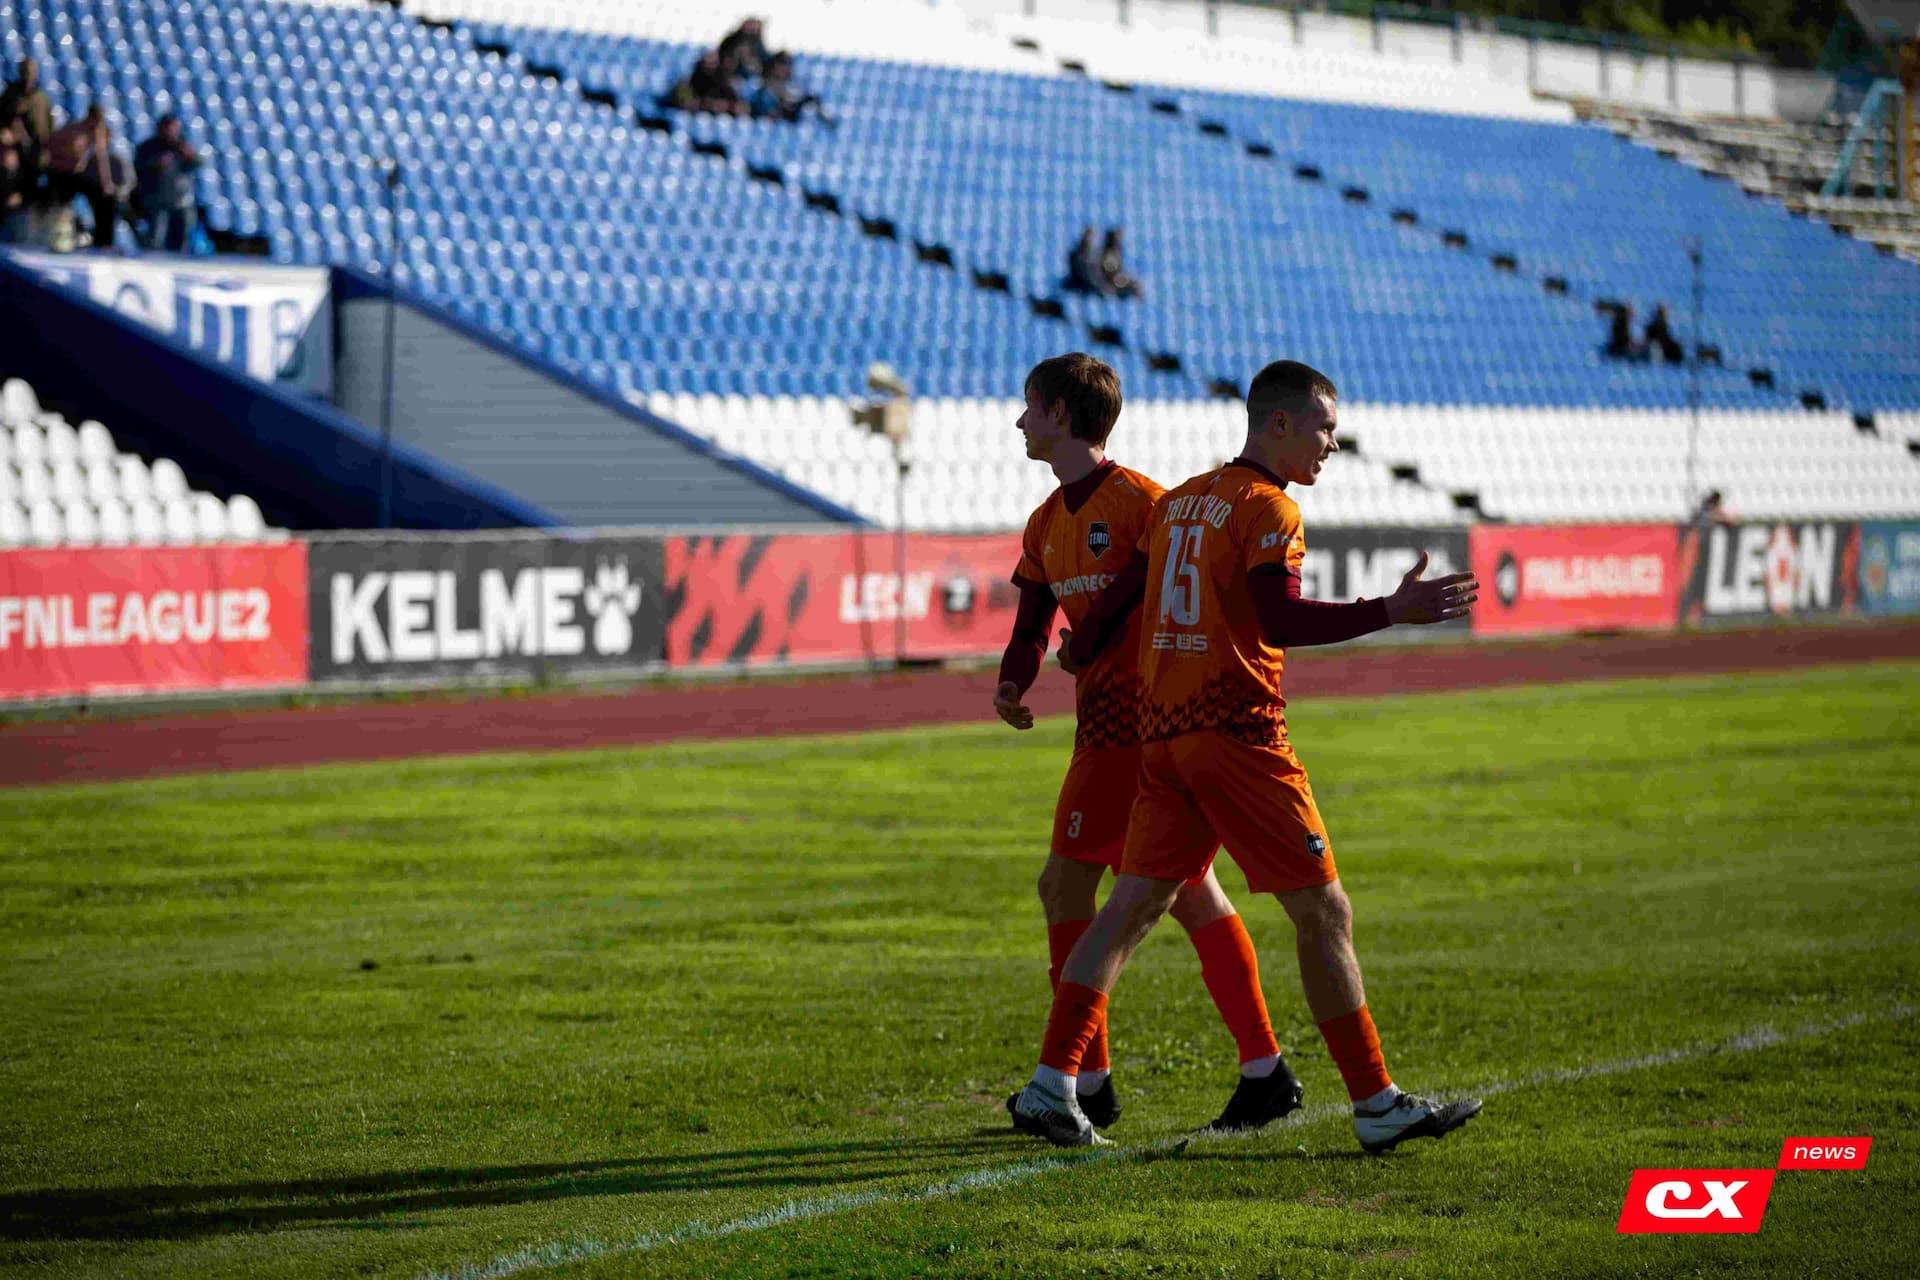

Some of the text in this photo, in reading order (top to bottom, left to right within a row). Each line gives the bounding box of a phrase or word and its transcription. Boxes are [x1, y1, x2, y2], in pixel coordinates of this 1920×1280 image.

[331, 567, 584, 664] KELME
[1159, 524, 1204, 626] 15
[1704, 522, 1836, 615] LEON
[1067, 811, 1083, 839] 3
